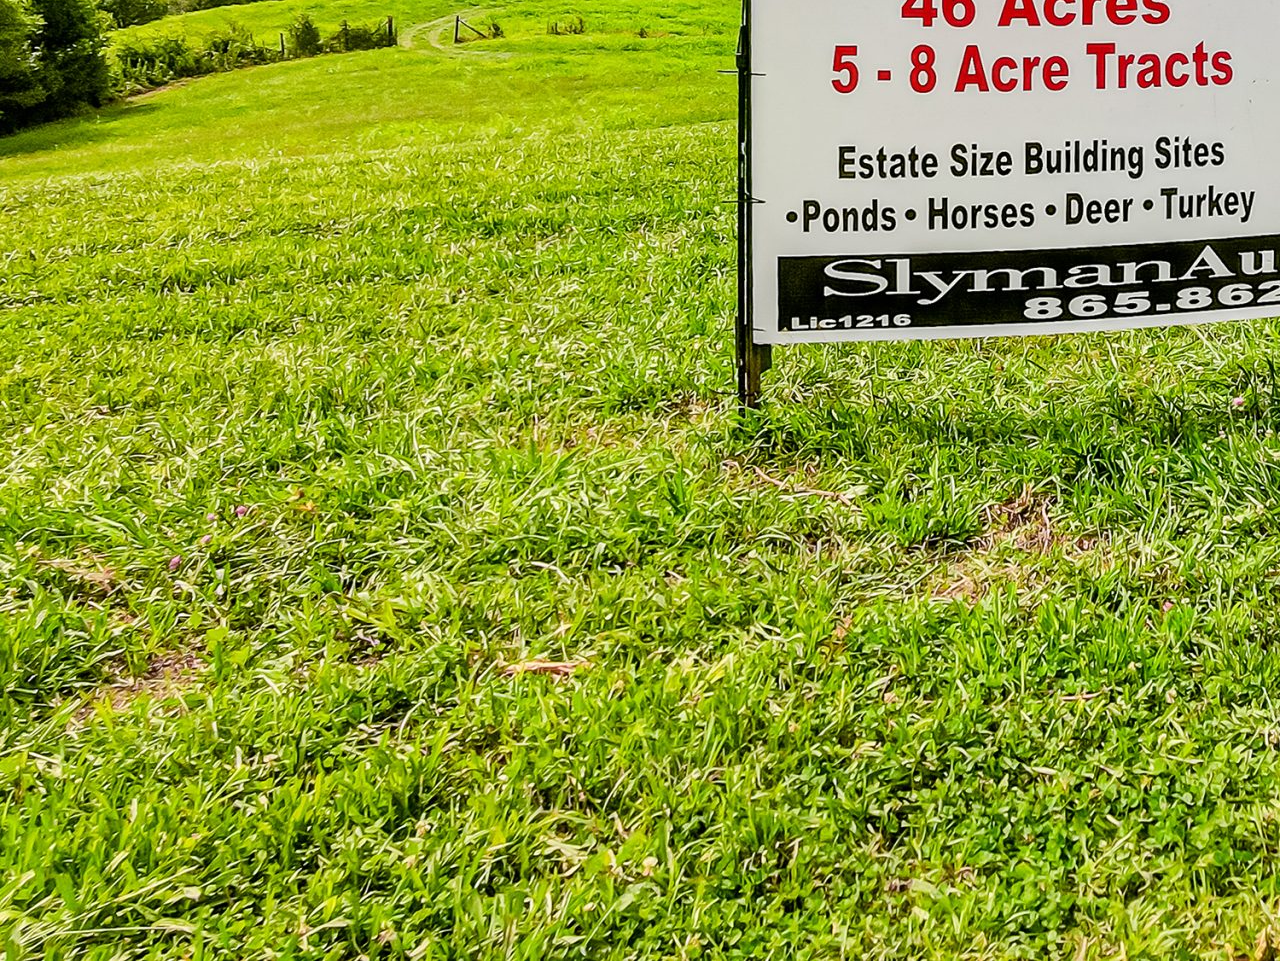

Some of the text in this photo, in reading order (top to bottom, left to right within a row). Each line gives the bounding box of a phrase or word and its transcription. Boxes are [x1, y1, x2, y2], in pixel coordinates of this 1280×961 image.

[831, 41, 1233, 93] 5 - 8 Acre Tracts
[838, 135, 1225, 180] Estate Size Building Sites
[802, 185, 1256, 233] Ponds Horses Deer Turkey
[791, 314, 912, 330] Lic1216
